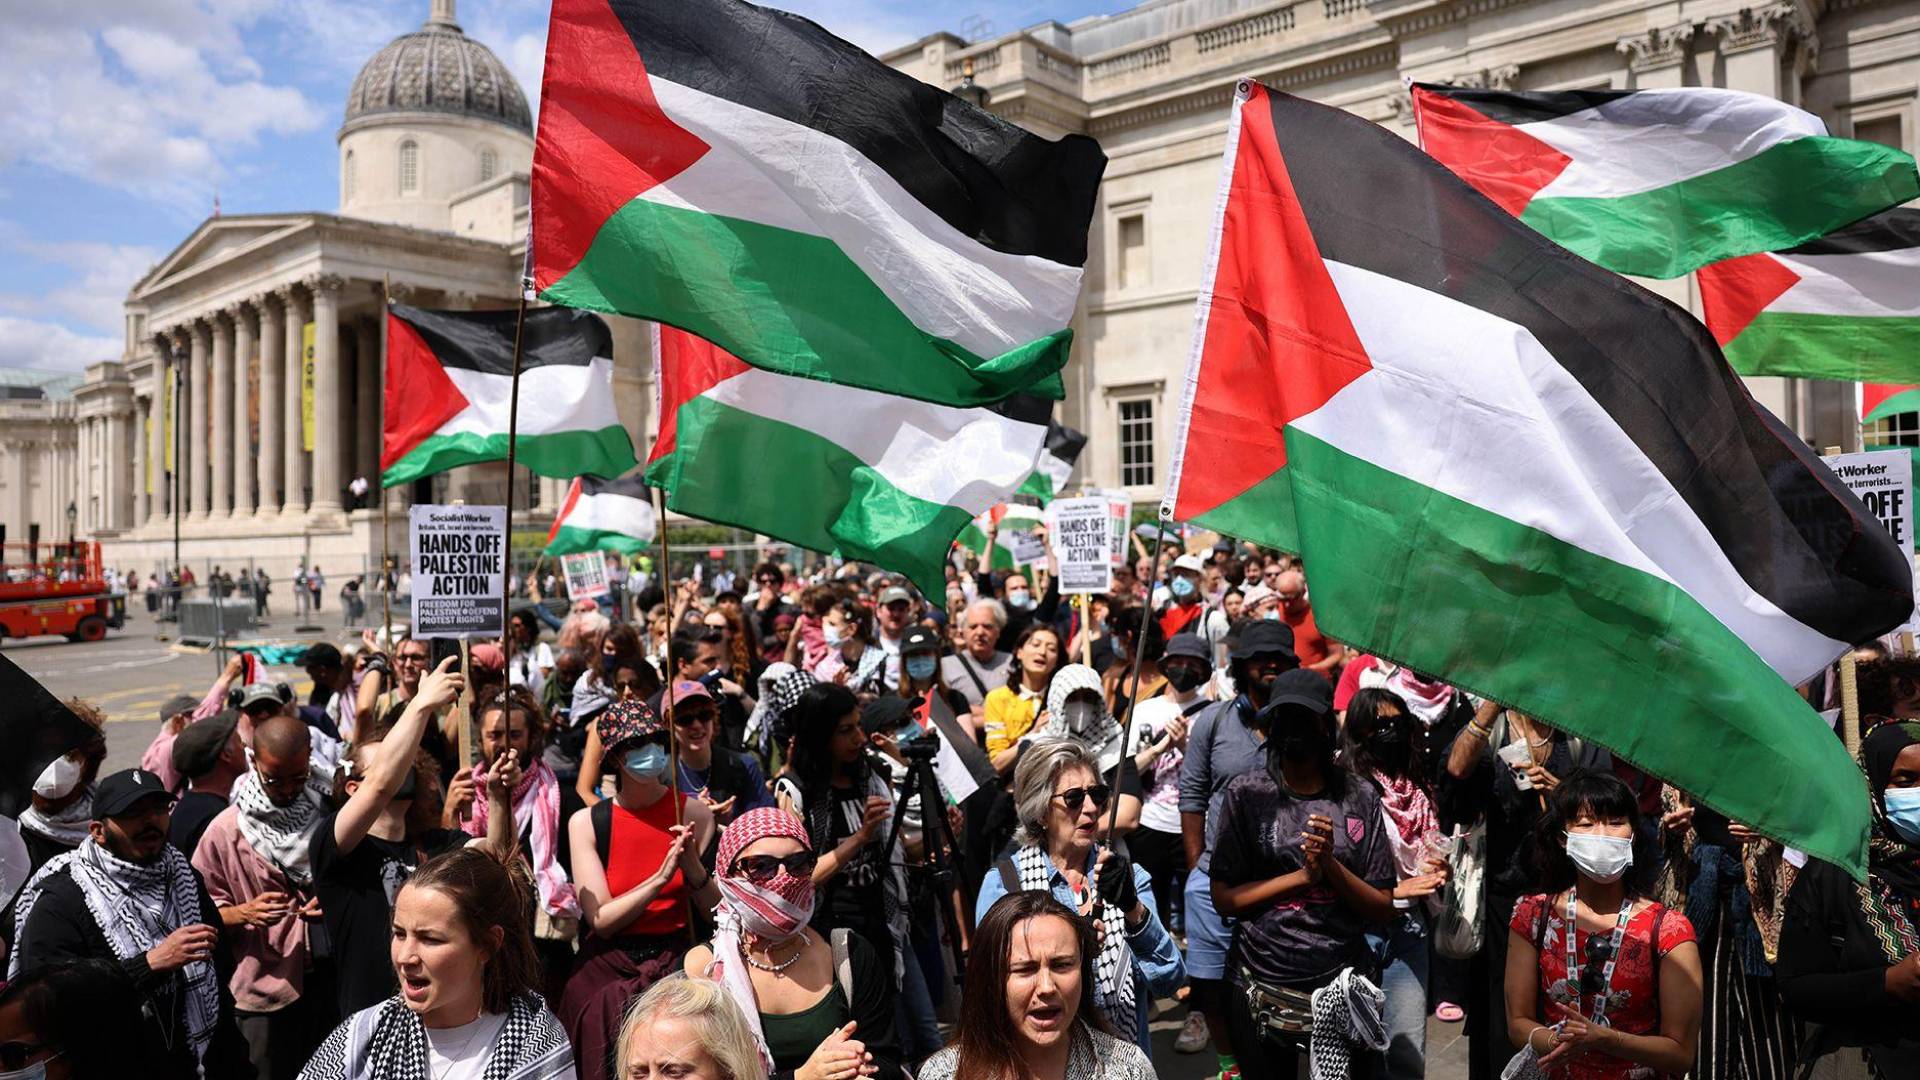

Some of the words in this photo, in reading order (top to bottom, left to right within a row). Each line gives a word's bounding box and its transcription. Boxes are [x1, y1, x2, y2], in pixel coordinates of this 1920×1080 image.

[1843, 464, 1887, 477] Worker
[1863, 489, 1904, 518] OFF
[430, 514, 464, 522] Socialist
[464, 514, 491, 522] Worker
[1059, 519, 1088, 533] HANDS
[1090, 518, 1106, 531] OFF
[420, 534, 472, 553] HANDS
[475, 535, 501, 553] OFF
[1060, 532, 1106, 547] PALESTINE
[1067, 548, 1100, 562] ACTION
[420, 555, 501, 574] PALESTINE
[432, 576, 489, 595] ACTION
[420, 600, 459, 608] FREEDOM
[460, 600, 475, 608] FOR
[420, 607, 461, 616] PALESTINE
[468, 607, 498, 615] DEFEND
[420, 616, 455, 624] PROTEST
[456, 615, 485, 624] RIGHTS
